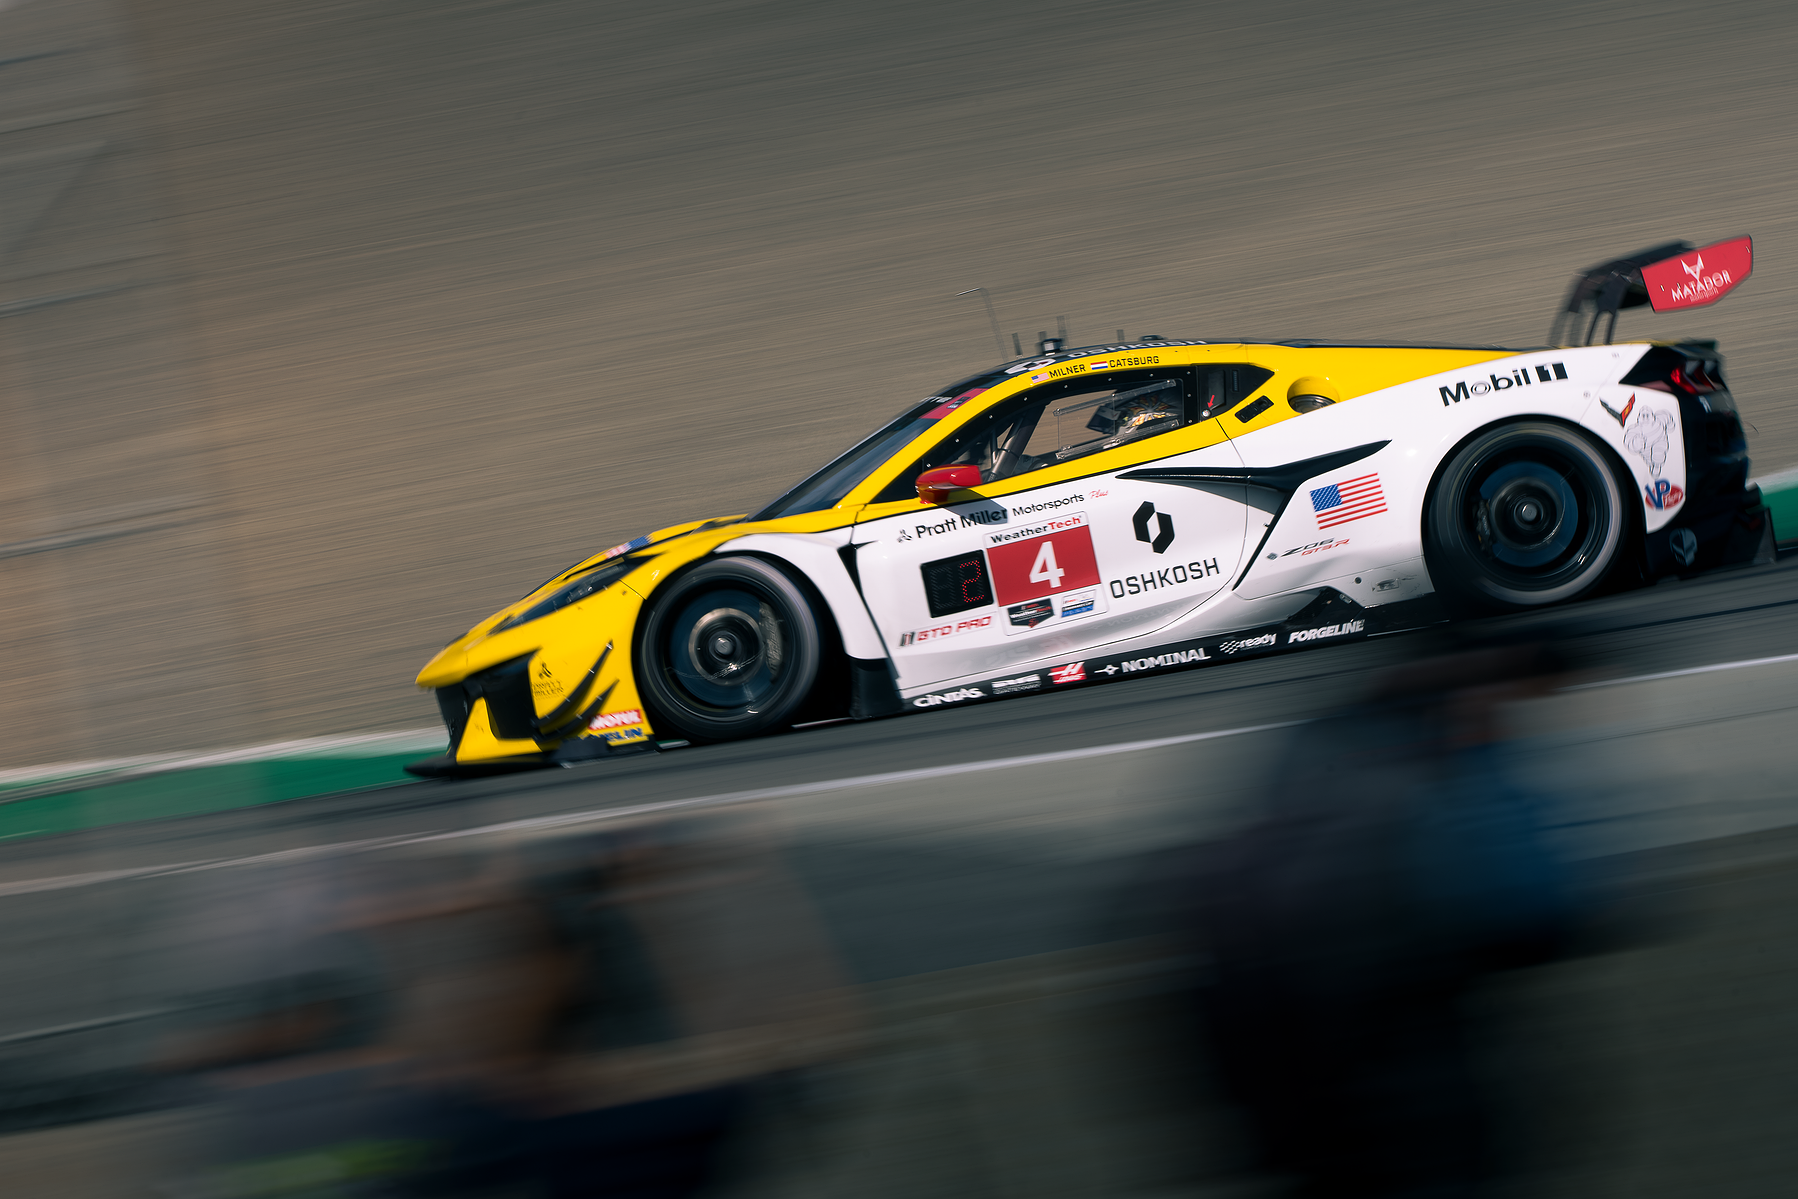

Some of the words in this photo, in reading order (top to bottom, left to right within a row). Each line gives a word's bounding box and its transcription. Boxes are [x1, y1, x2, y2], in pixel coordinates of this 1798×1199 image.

[1670, 269, 1732, 302] MATADOR
[1049, 363, 1086, 379] MILNER
[1109, 354, 1160, 369] CATSBURG
[1439, 367, 1532, 407] Mobil
[1645, 478, 1671, 511] VP
[915, 516, 957, 539] Pratt
[960, 507, 1009, 529] Miller
[1012, 493, 1085, 517] Motorsports
[990, 516, 1082, 544] WeatherTech
[1029, 541, 1065, 589] 4
[1109, 557, 1221, 599] OSHKOSH
[960, 560, 985, 603] 2
[955, 615, 993, 633] PRO
[1287, 618, 1366, 644] FORGELINE
[1239, 633, 1277, 649] ready
[1121, 647, 1211, 673] NOMINAL
